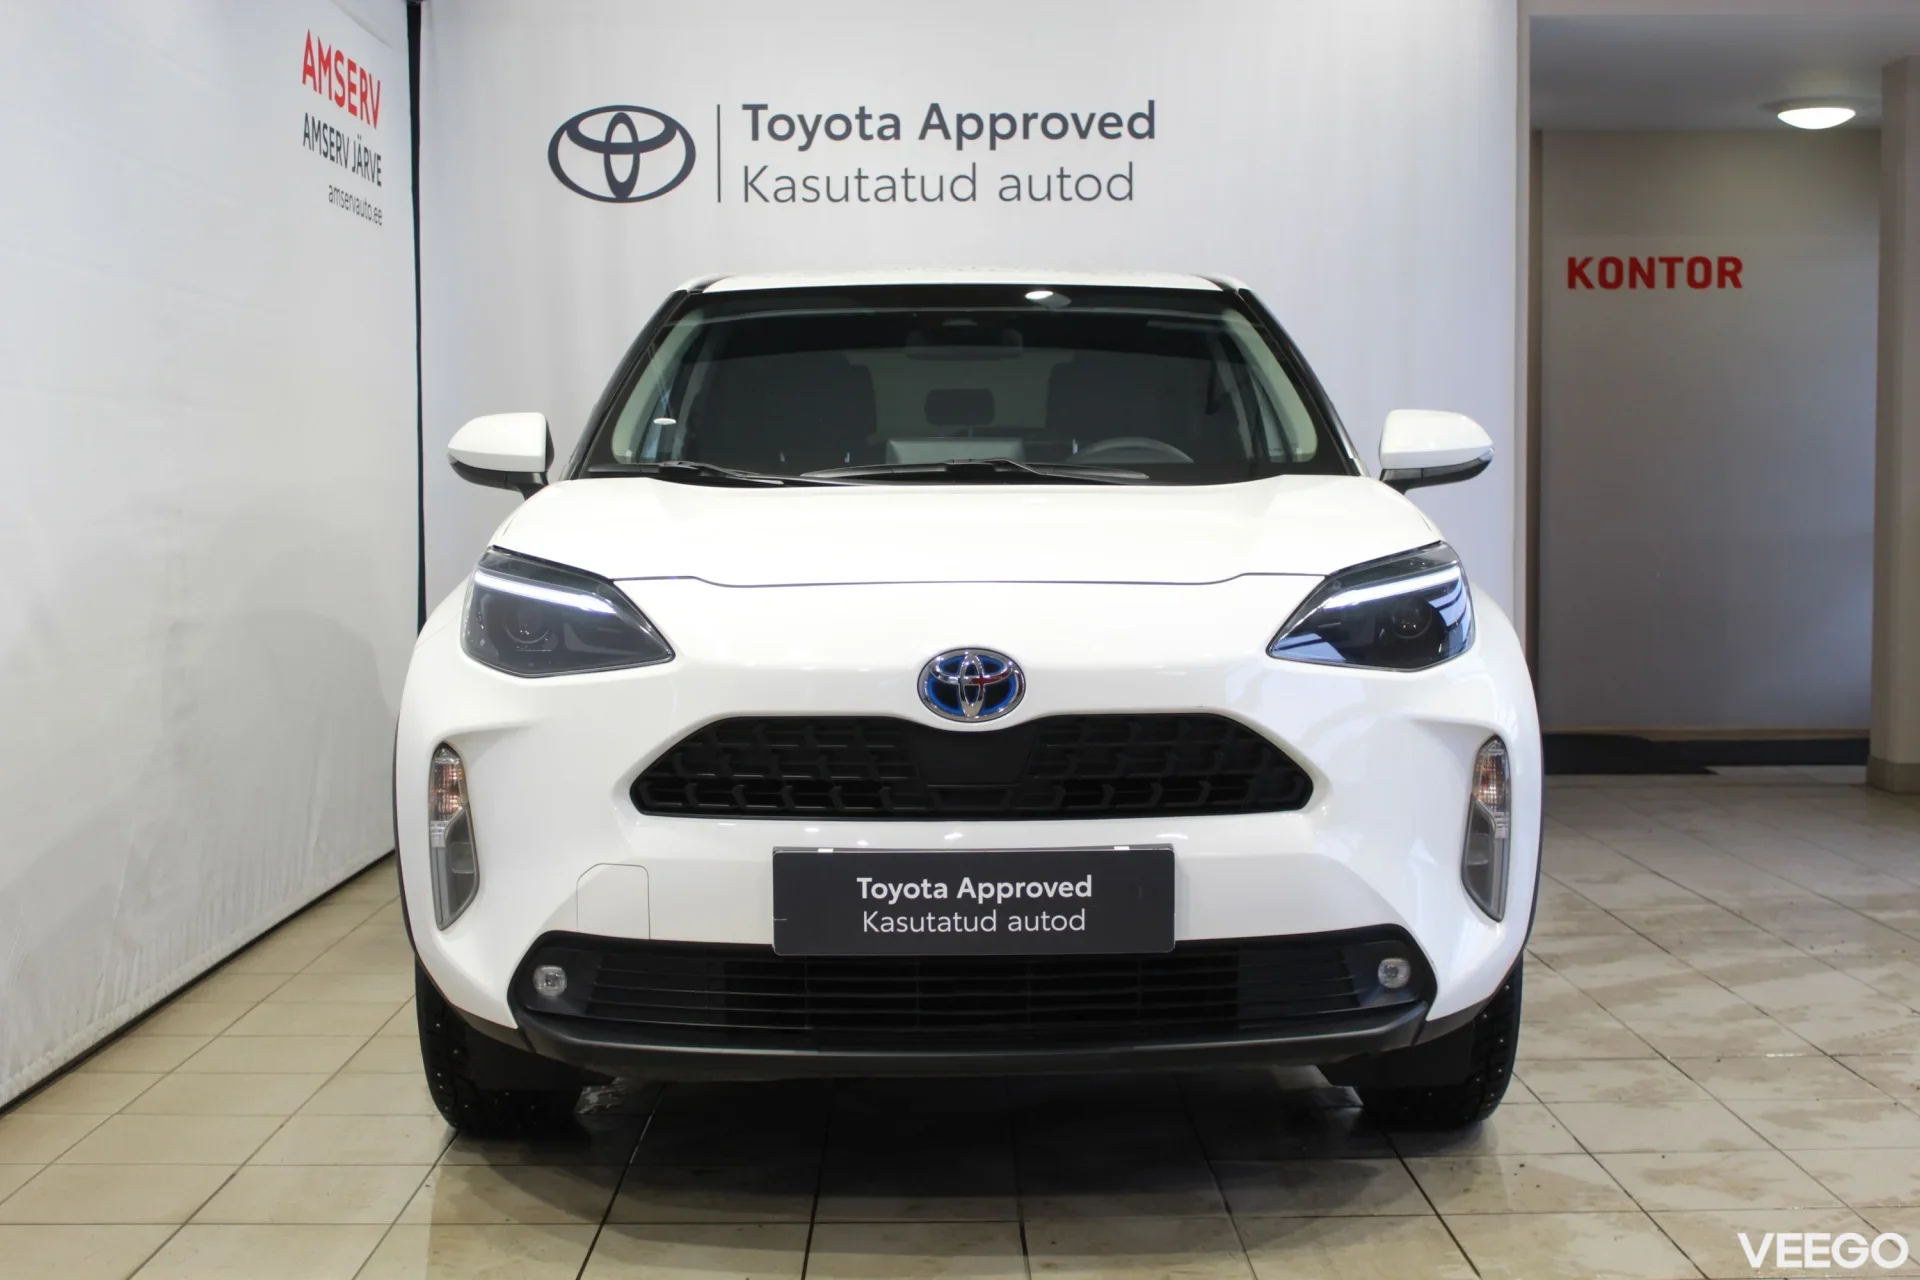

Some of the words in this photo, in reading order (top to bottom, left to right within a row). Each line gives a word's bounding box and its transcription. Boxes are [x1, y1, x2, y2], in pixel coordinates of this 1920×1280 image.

[302, 28, 381, 129] AMSERV
[742, 103, 901, 152] Toyota
[918, 100, 1155, 151] Approved
[303, 112, 350, 169] AMSERV
[352, 134, 382, 187] JÄRVE
[743, 162, 977, 203] Kasutatud
[998, 161, 1134, 202] autod
[328, 184, 383, 226] amservauto.ee
[1567, 256, 1743, 290] KONTOR
[857, 877, 948, 905] Toyota
[956, 874, 1093, 904] Approved
[863, 909, 997, 933] Kasutatud
[1007, 908, 1086, 932] autod
